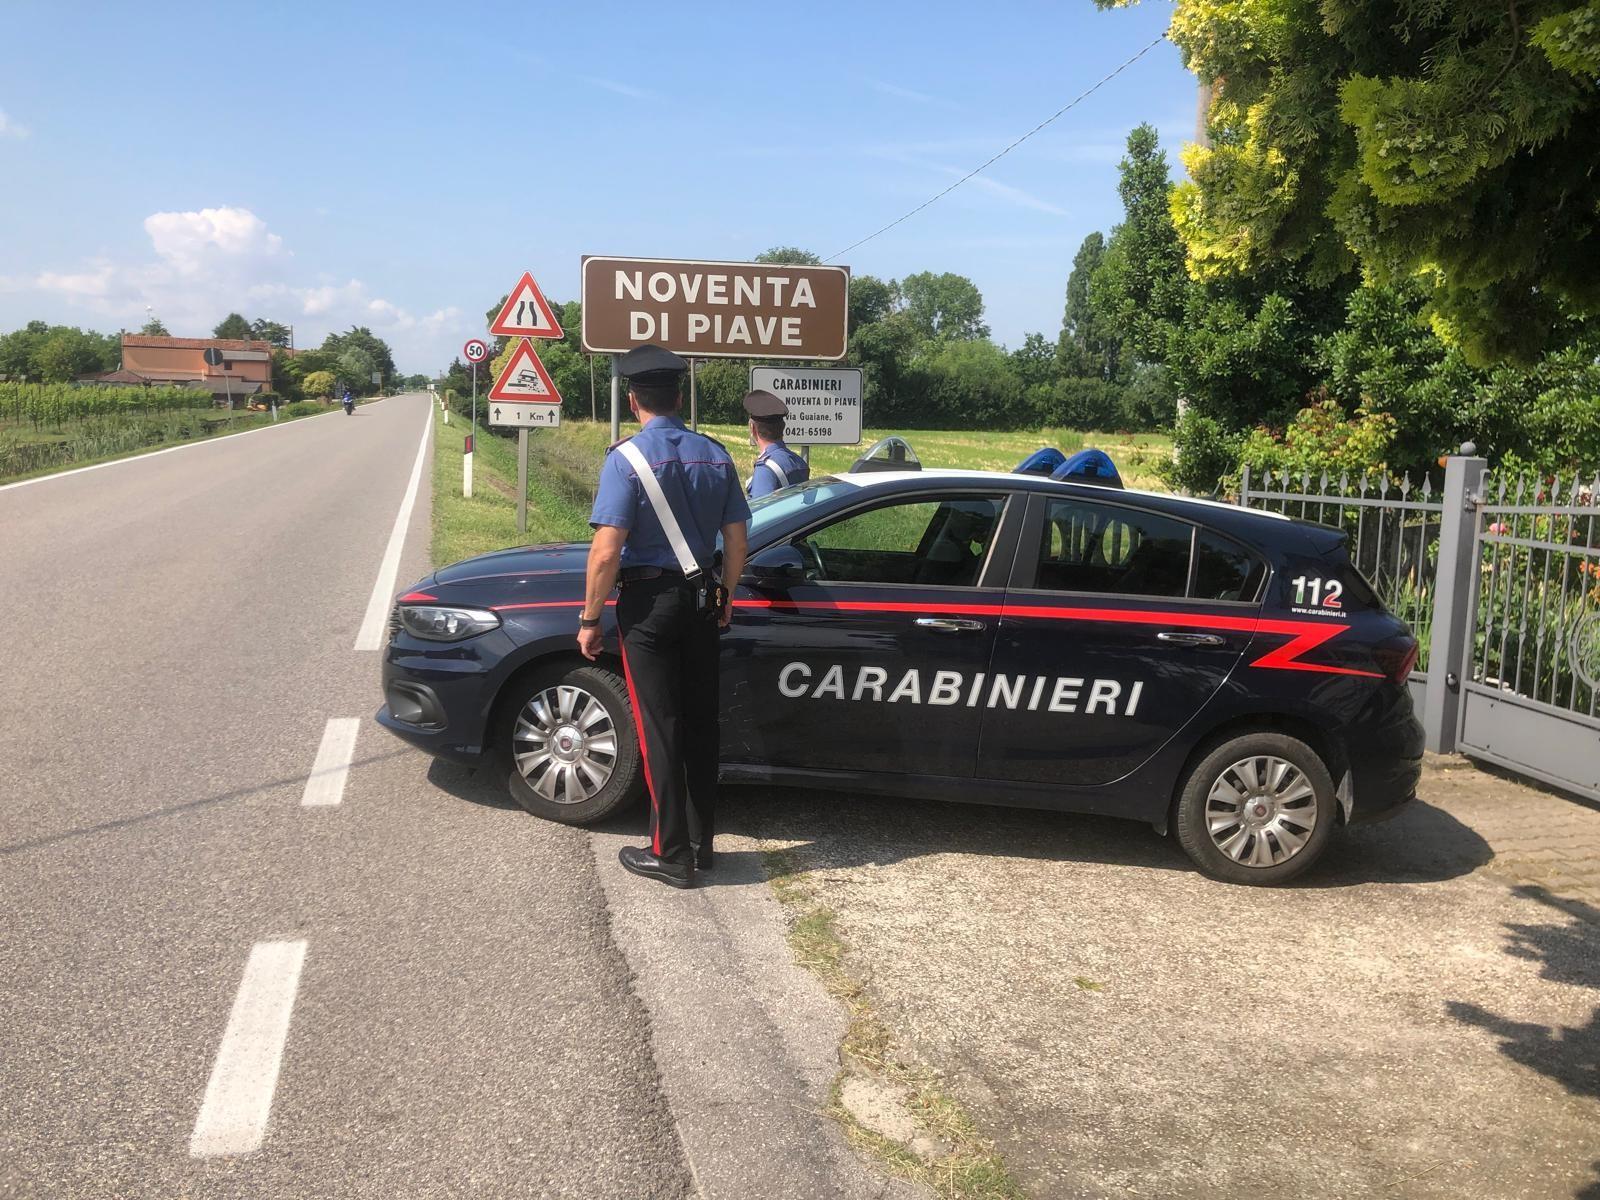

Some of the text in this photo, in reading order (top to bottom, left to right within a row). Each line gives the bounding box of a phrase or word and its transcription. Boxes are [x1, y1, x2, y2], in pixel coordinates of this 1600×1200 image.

[615, 270, 817, 308] NOVENTA
[630, 311, 802, 346] DI PIAVE
[469, 346, 482, 356] 50
[773, 378, 842, 391] CARABINIERI
[785, 396, 857, 406] NOVENTA DI PIAVE
[516, 412, 544, 420] 1 Km
[835, 411, 843, 421] 16
[785, 427, 832, 436] 0421-65198
[1291, 575, 1343, 608] 112
[1291, 608, 1346, 618] www.carabinieri.it
[777, 661, 1144, 716] CARABINIERI
